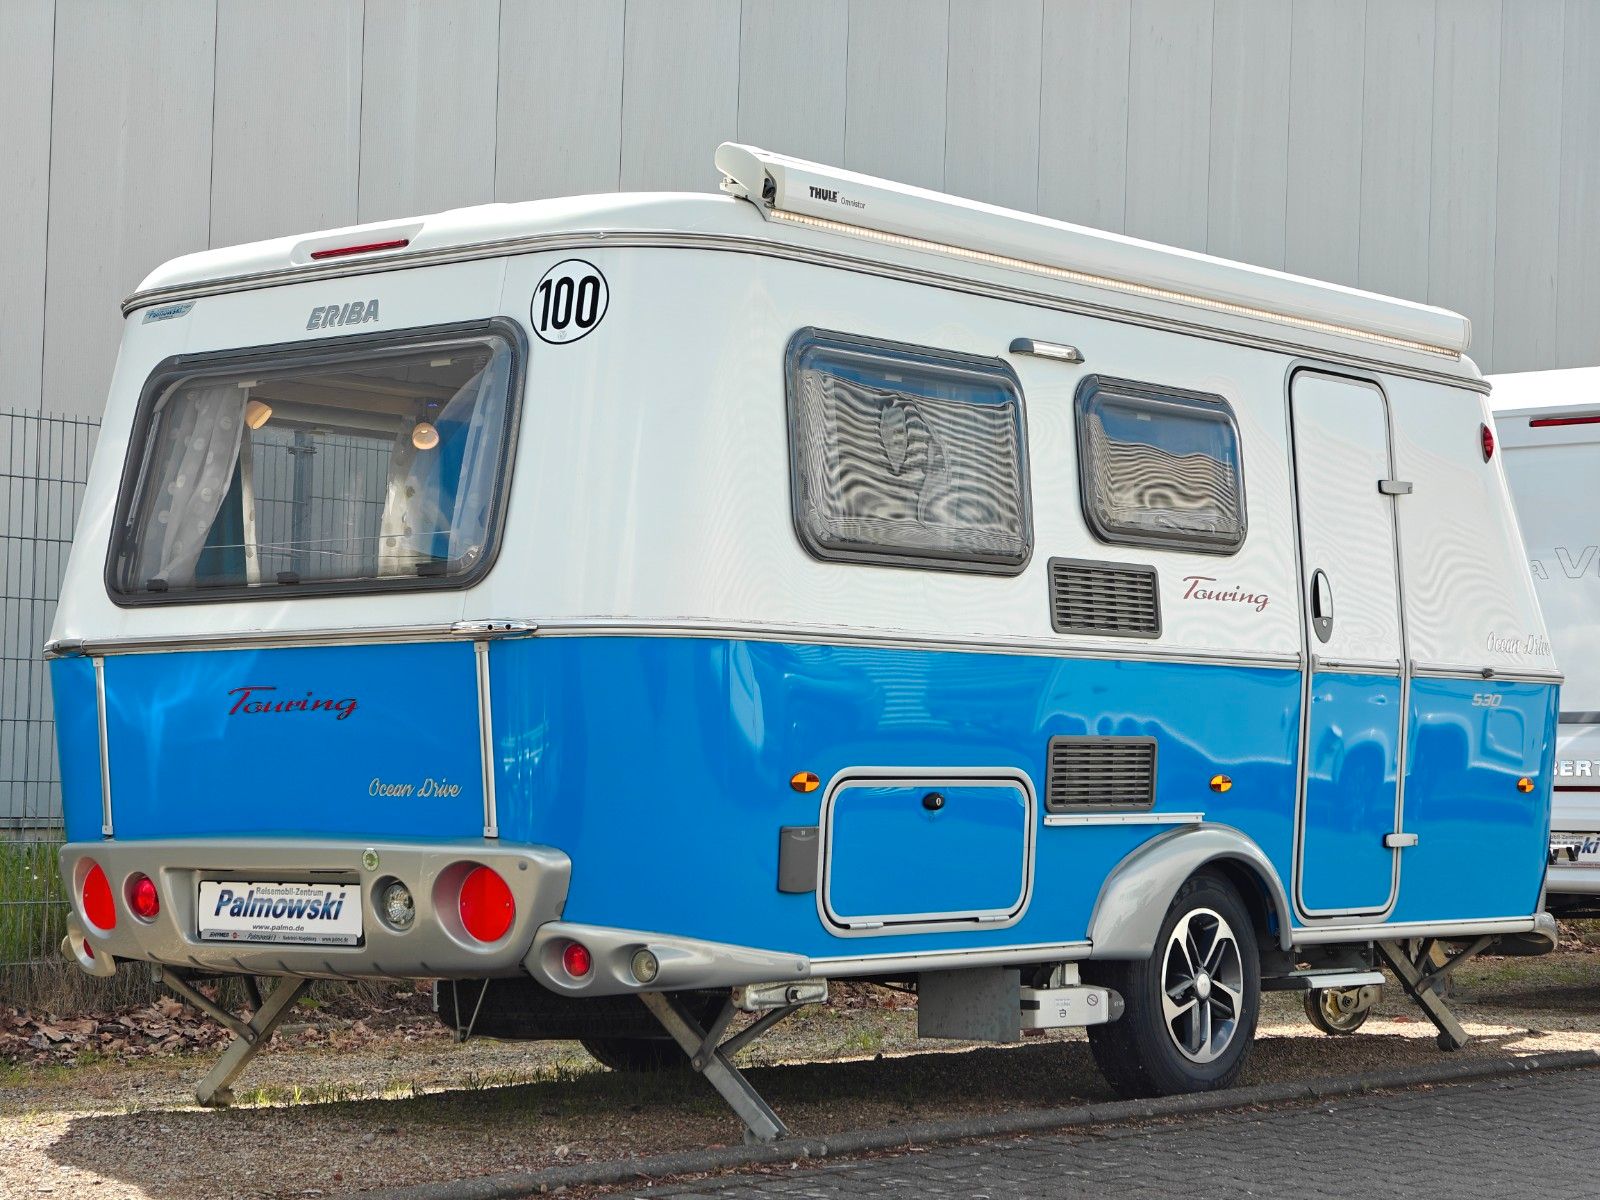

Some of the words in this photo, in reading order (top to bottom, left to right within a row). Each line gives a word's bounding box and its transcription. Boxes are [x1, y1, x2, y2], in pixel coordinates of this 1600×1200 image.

[809, 185, 838, 203] THULE
[840, 196, 866, 209] Omnistor
[306, 299, 379, 331] ERIBA
[539, 275, 601, 332] 100
[1182, 575, 1270, 613] Touring
[1487, 631, 1520, 655] Ocean
[228, 685, 358, 721] Touring
[1471, 693, 1503, 707] 530
[368, 777, 415, 797] Ocean
[417, 777, 463, 798] Drive
[255, 886, 324, 897] Reisemobil-Zentrum
[214, 889, 346, 921] Palmowski
[252, 923, 305, 932] www.palmo.de
